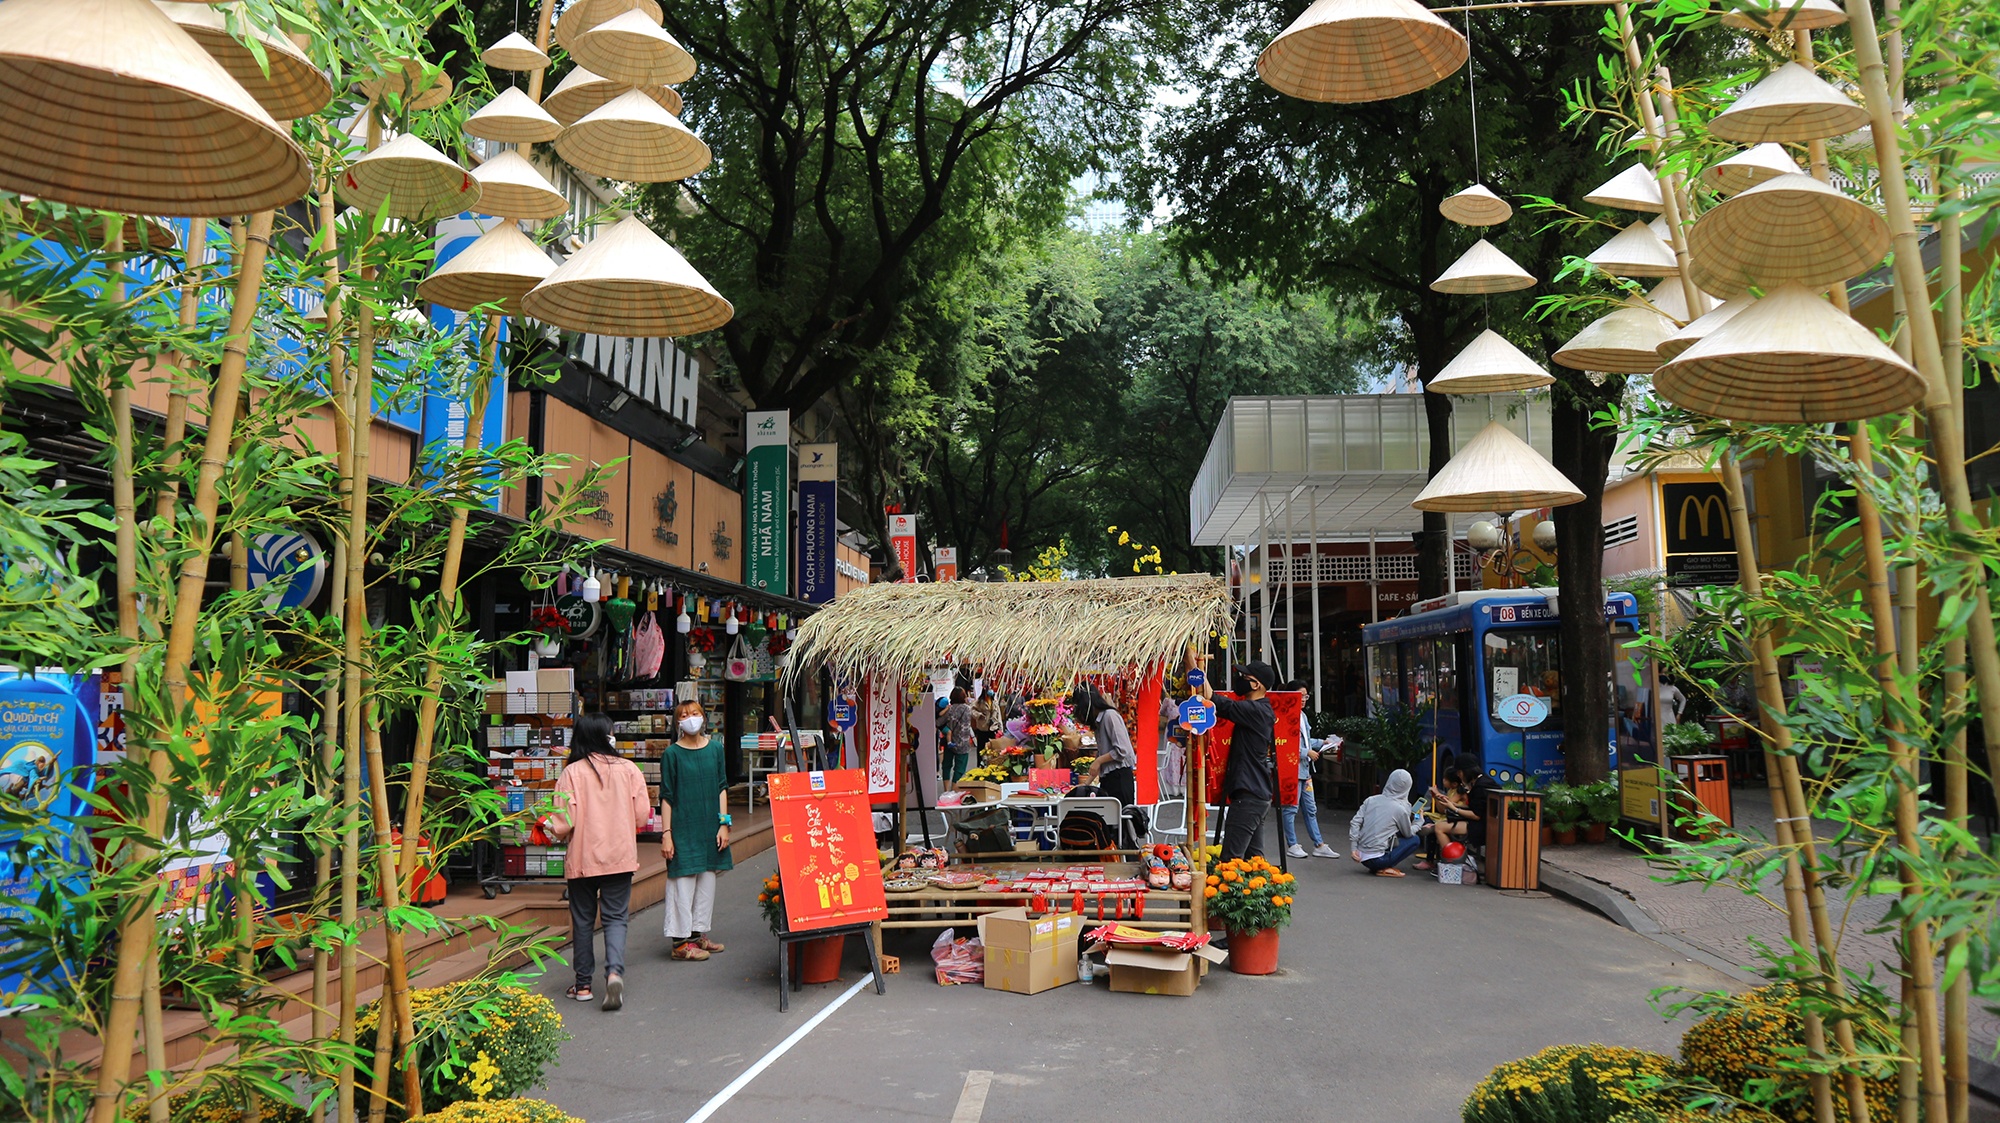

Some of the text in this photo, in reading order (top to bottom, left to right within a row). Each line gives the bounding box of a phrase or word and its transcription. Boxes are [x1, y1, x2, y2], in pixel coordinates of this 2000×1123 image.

[582, 331, 699, 430] MINH
[818, 502, 826, 526] BOOK
[758, 490, 772, 556] NHÃ NAM
[805, 494, 816, 592] SÁCH PHƯƠNG NAM
[818, 528, 826, 547] NAM
[1379, 593, 1399, 601] CAFE
[1501, 608, 1515, 620] 08
[1534, 609, 1542, 618] XE
[1606, 605, 1618, 615] GIA
[3, 711, 59, 724] QUIDDITCH
